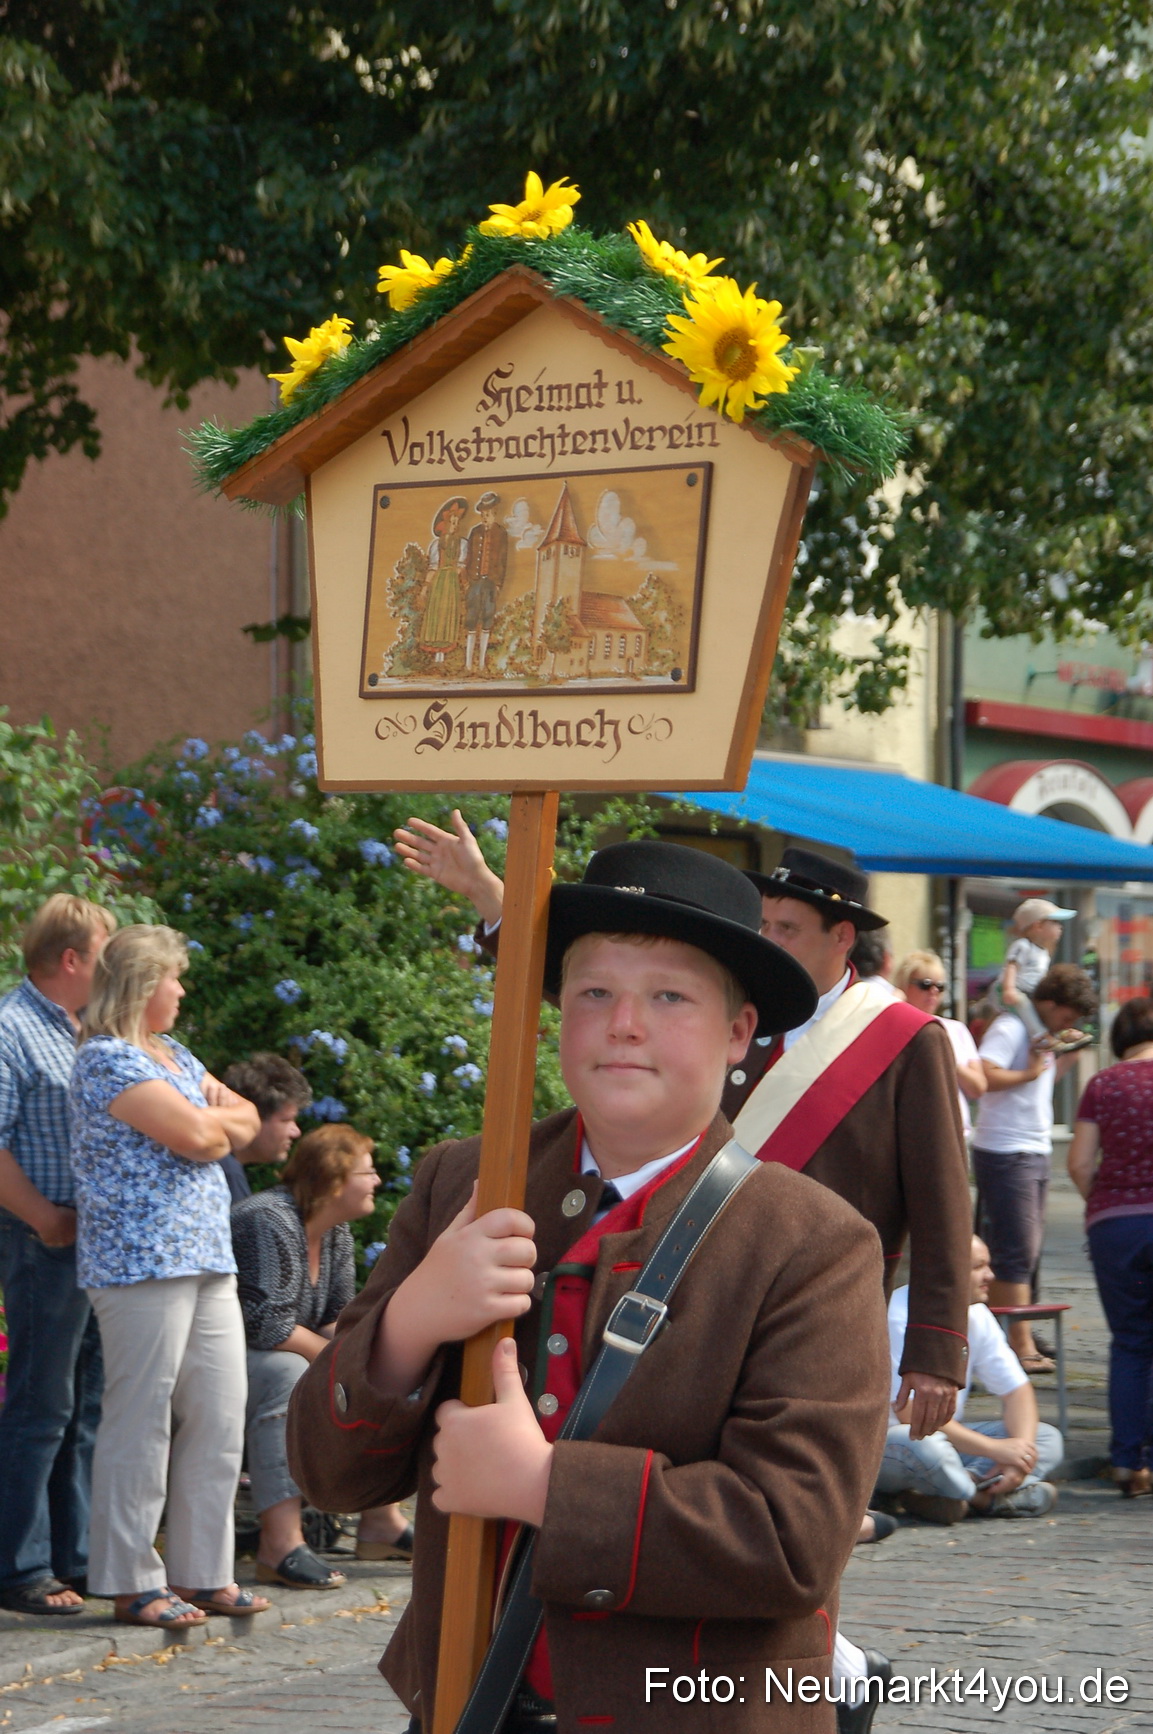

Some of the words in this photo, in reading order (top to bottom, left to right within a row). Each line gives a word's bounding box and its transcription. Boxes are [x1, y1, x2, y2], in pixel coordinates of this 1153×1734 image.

[476, 361, 609, 428] Heimat
[615, 379, 643, 405] u.
[414, 698, 623, 764] Sindlbach
